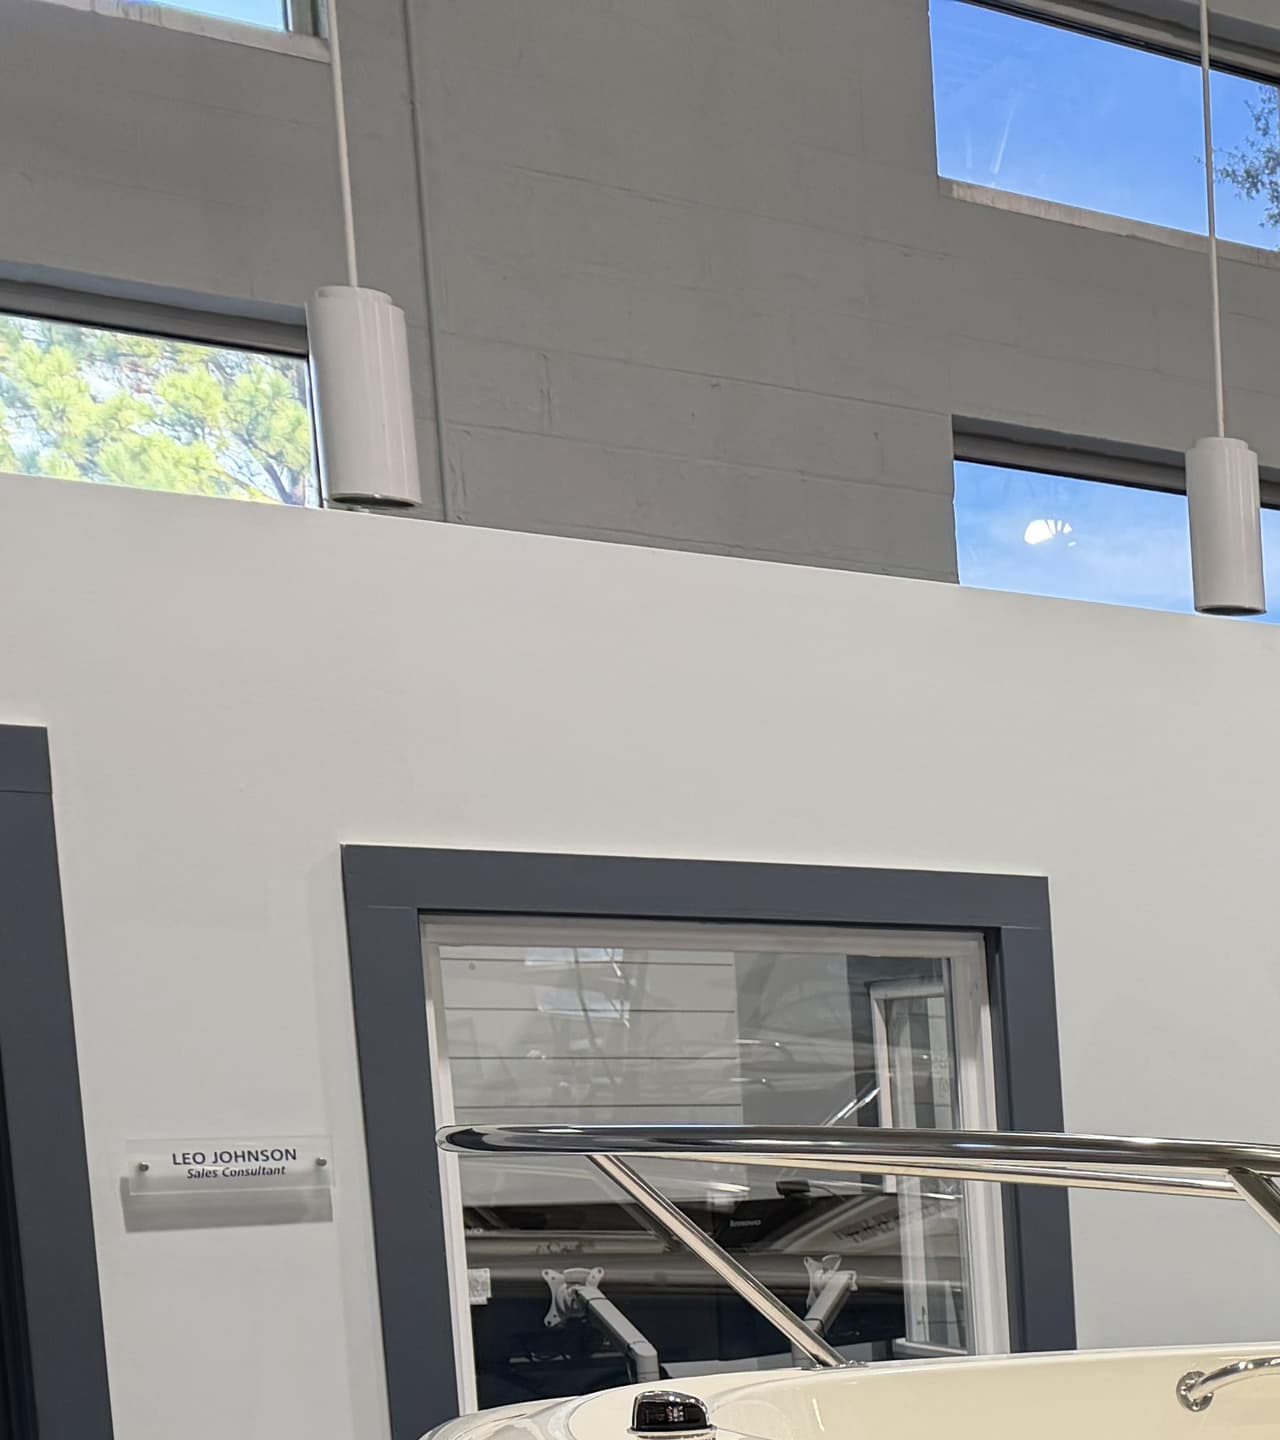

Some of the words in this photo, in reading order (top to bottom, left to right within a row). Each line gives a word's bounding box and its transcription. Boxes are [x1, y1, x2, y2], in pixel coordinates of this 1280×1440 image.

[172, 1151, 205, 1166] LEO
[212, 1148, 297, 1164] JOHNSON
[187, 1167, 218, 1179] Sales
[222, 1165, 287, 1178] Consultant
